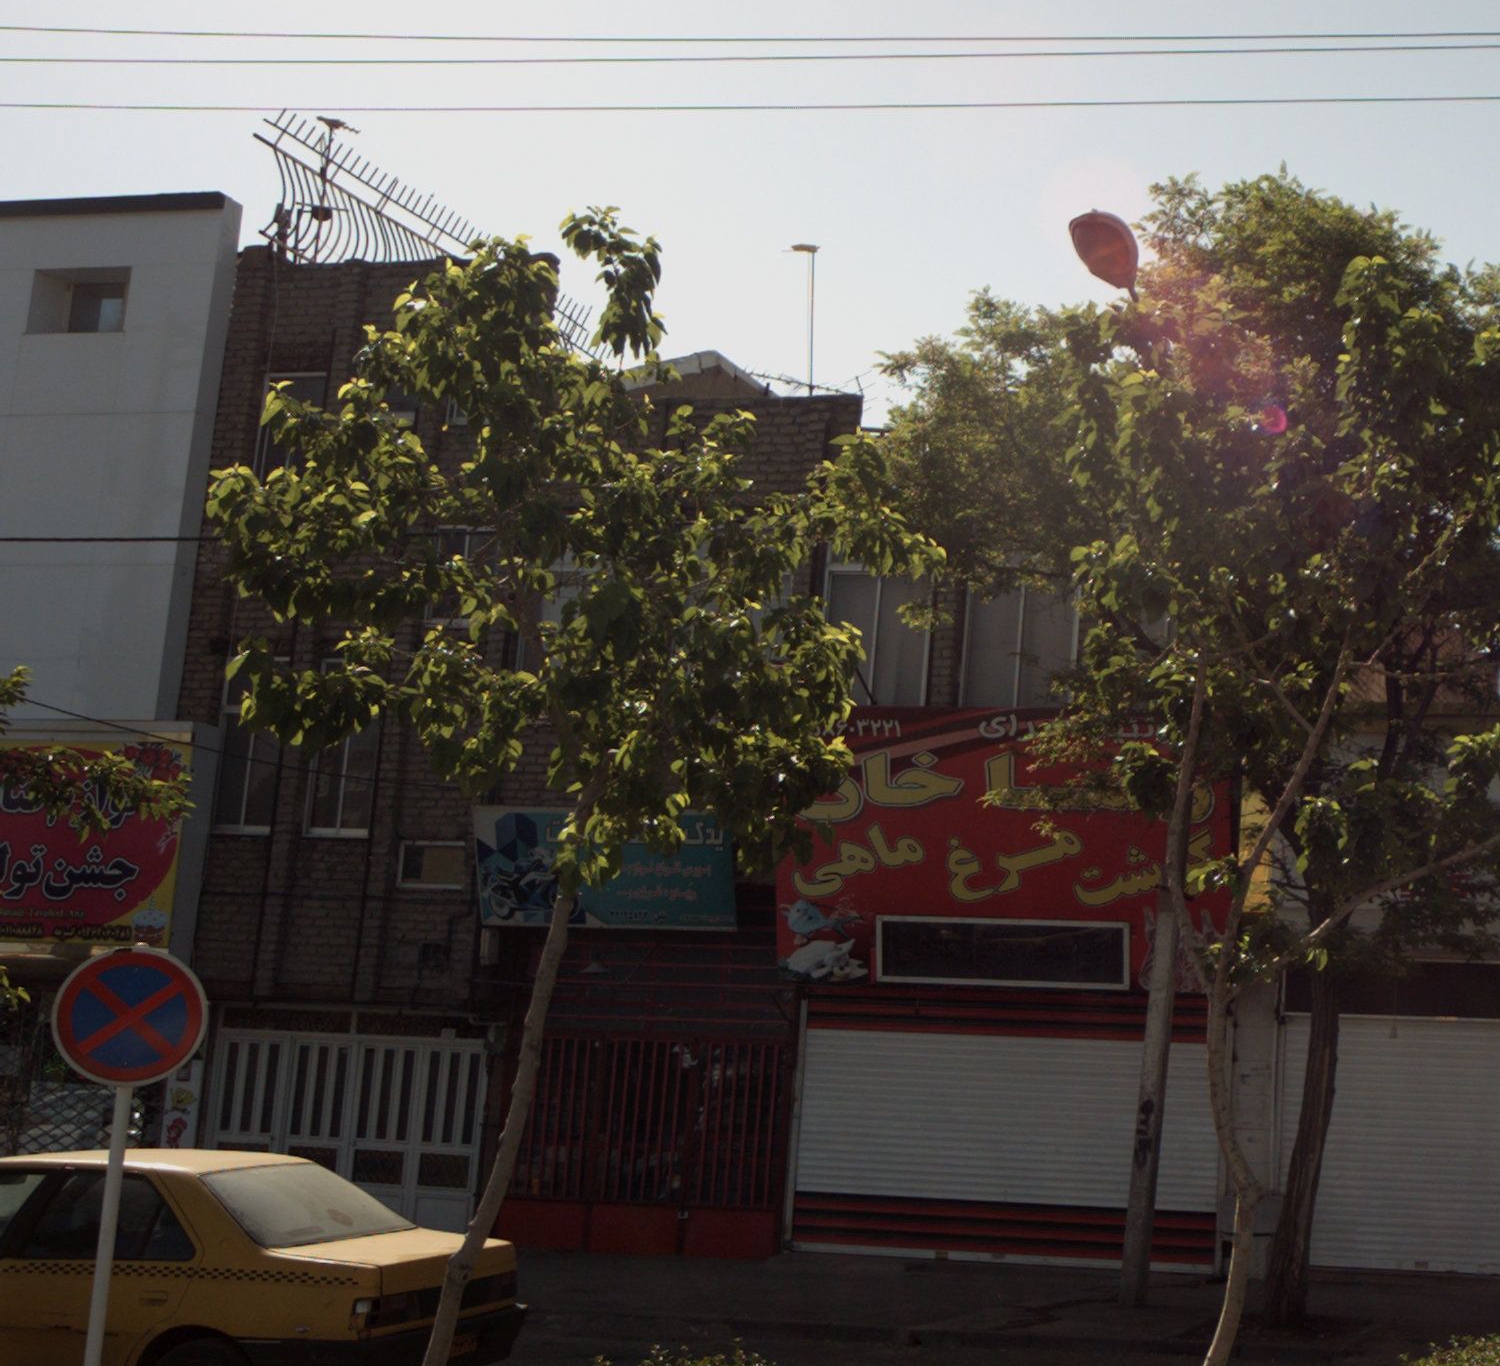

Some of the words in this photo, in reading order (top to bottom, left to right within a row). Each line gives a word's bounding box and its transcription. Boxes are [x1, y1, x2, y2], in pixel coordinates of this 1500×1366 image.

[43, 845, 140, 901] جشن
[792, 822, 926, 899] ماهی
[947, 828, 1083, 903] مرغ
